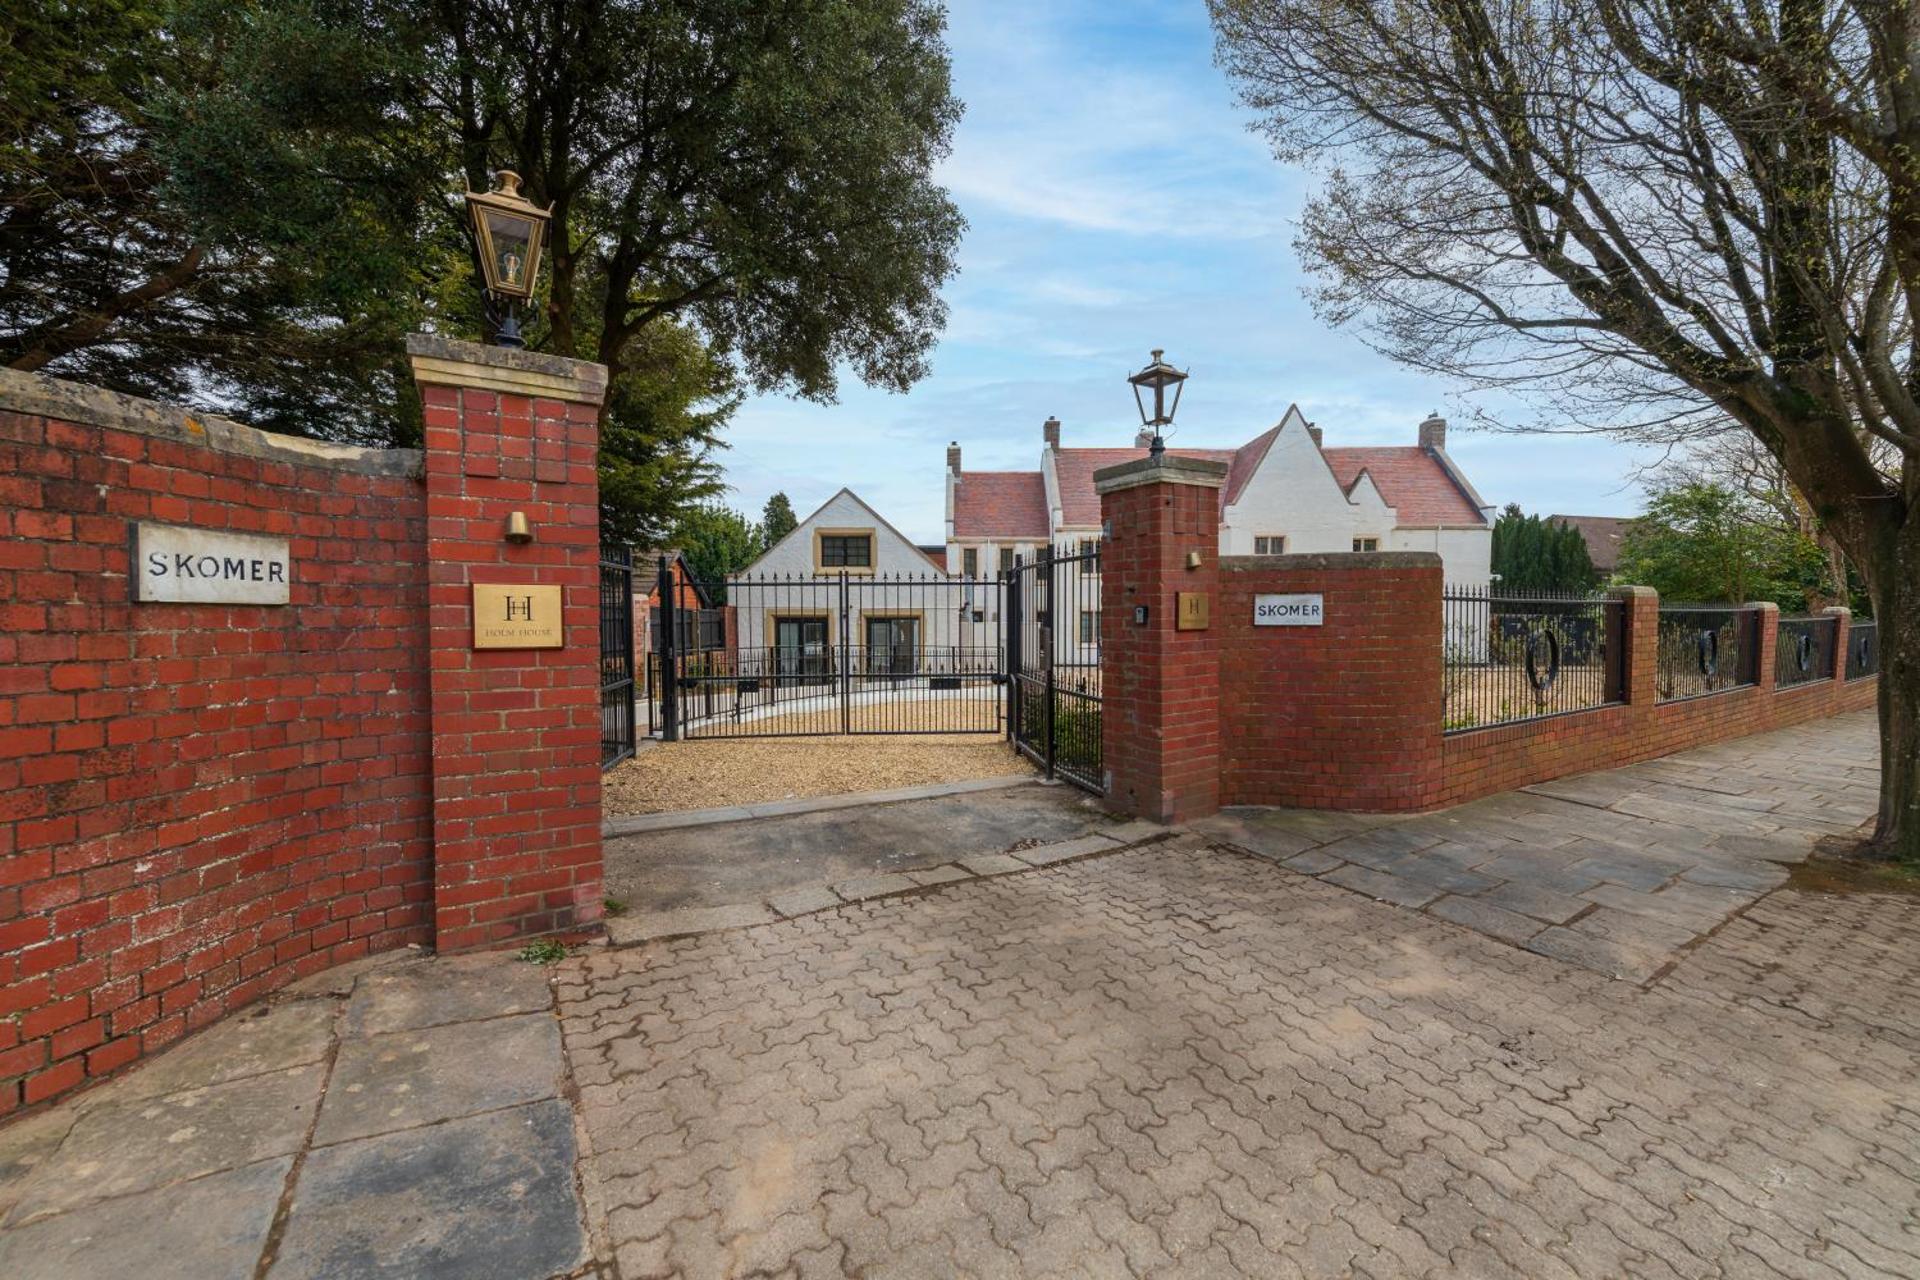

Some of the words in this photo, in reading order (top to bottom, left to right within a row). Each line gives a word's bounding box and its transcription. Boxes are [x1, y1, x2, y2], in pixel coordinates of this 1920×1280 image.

[149, 552, 284, 583] SKOMER
[1258, 604, 1320, 617] SKOMER
[519, 628, 553, 637] HOUSE
